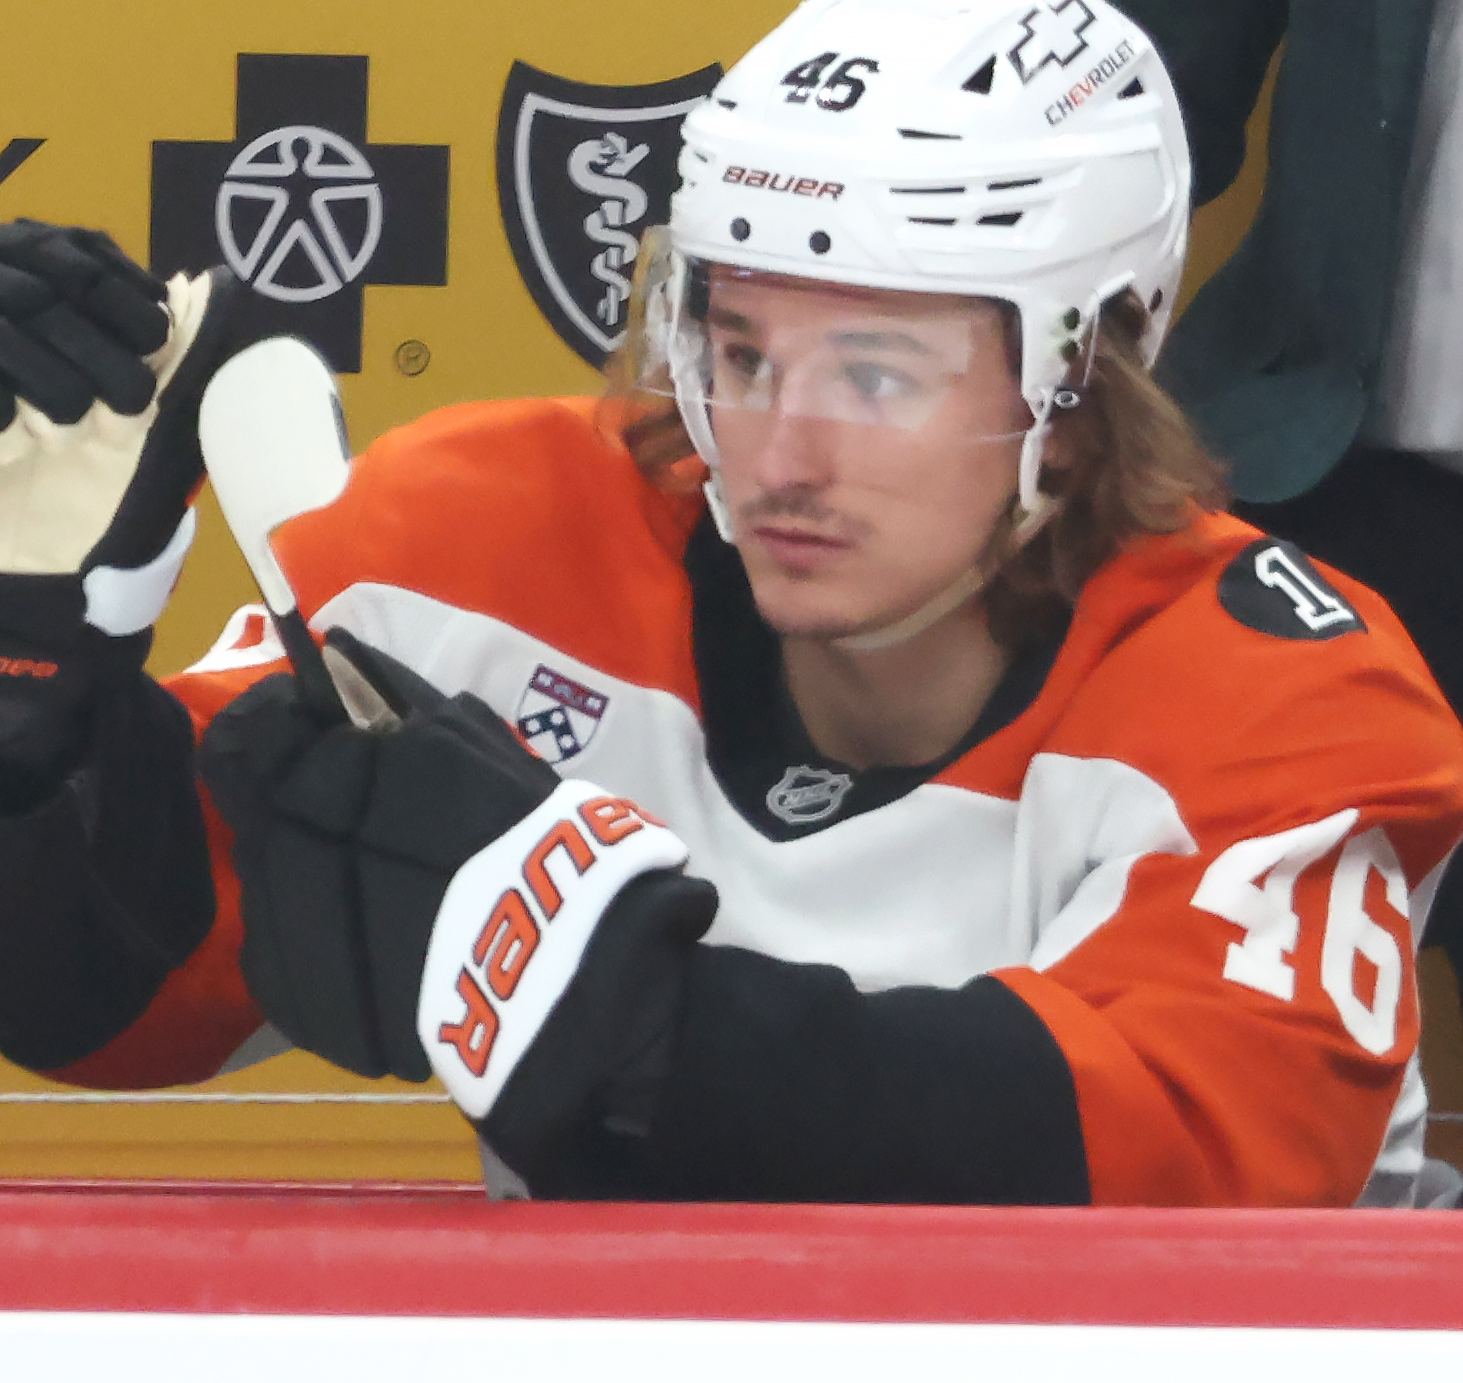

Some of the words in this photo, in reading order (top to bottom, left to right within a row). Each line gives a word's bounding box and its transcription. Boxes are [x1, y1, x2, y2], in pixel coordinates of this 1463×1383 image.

[780, 51, 881, 112] 46
[1043, 38, 1138, 127] CHEVROLET
[722, 165, 846, 201] BAUER
[1254, 546, 1354, 631] 1
[438, 795, 668, 1078] AUER
[1188, 807, 1412, 1056] 46
